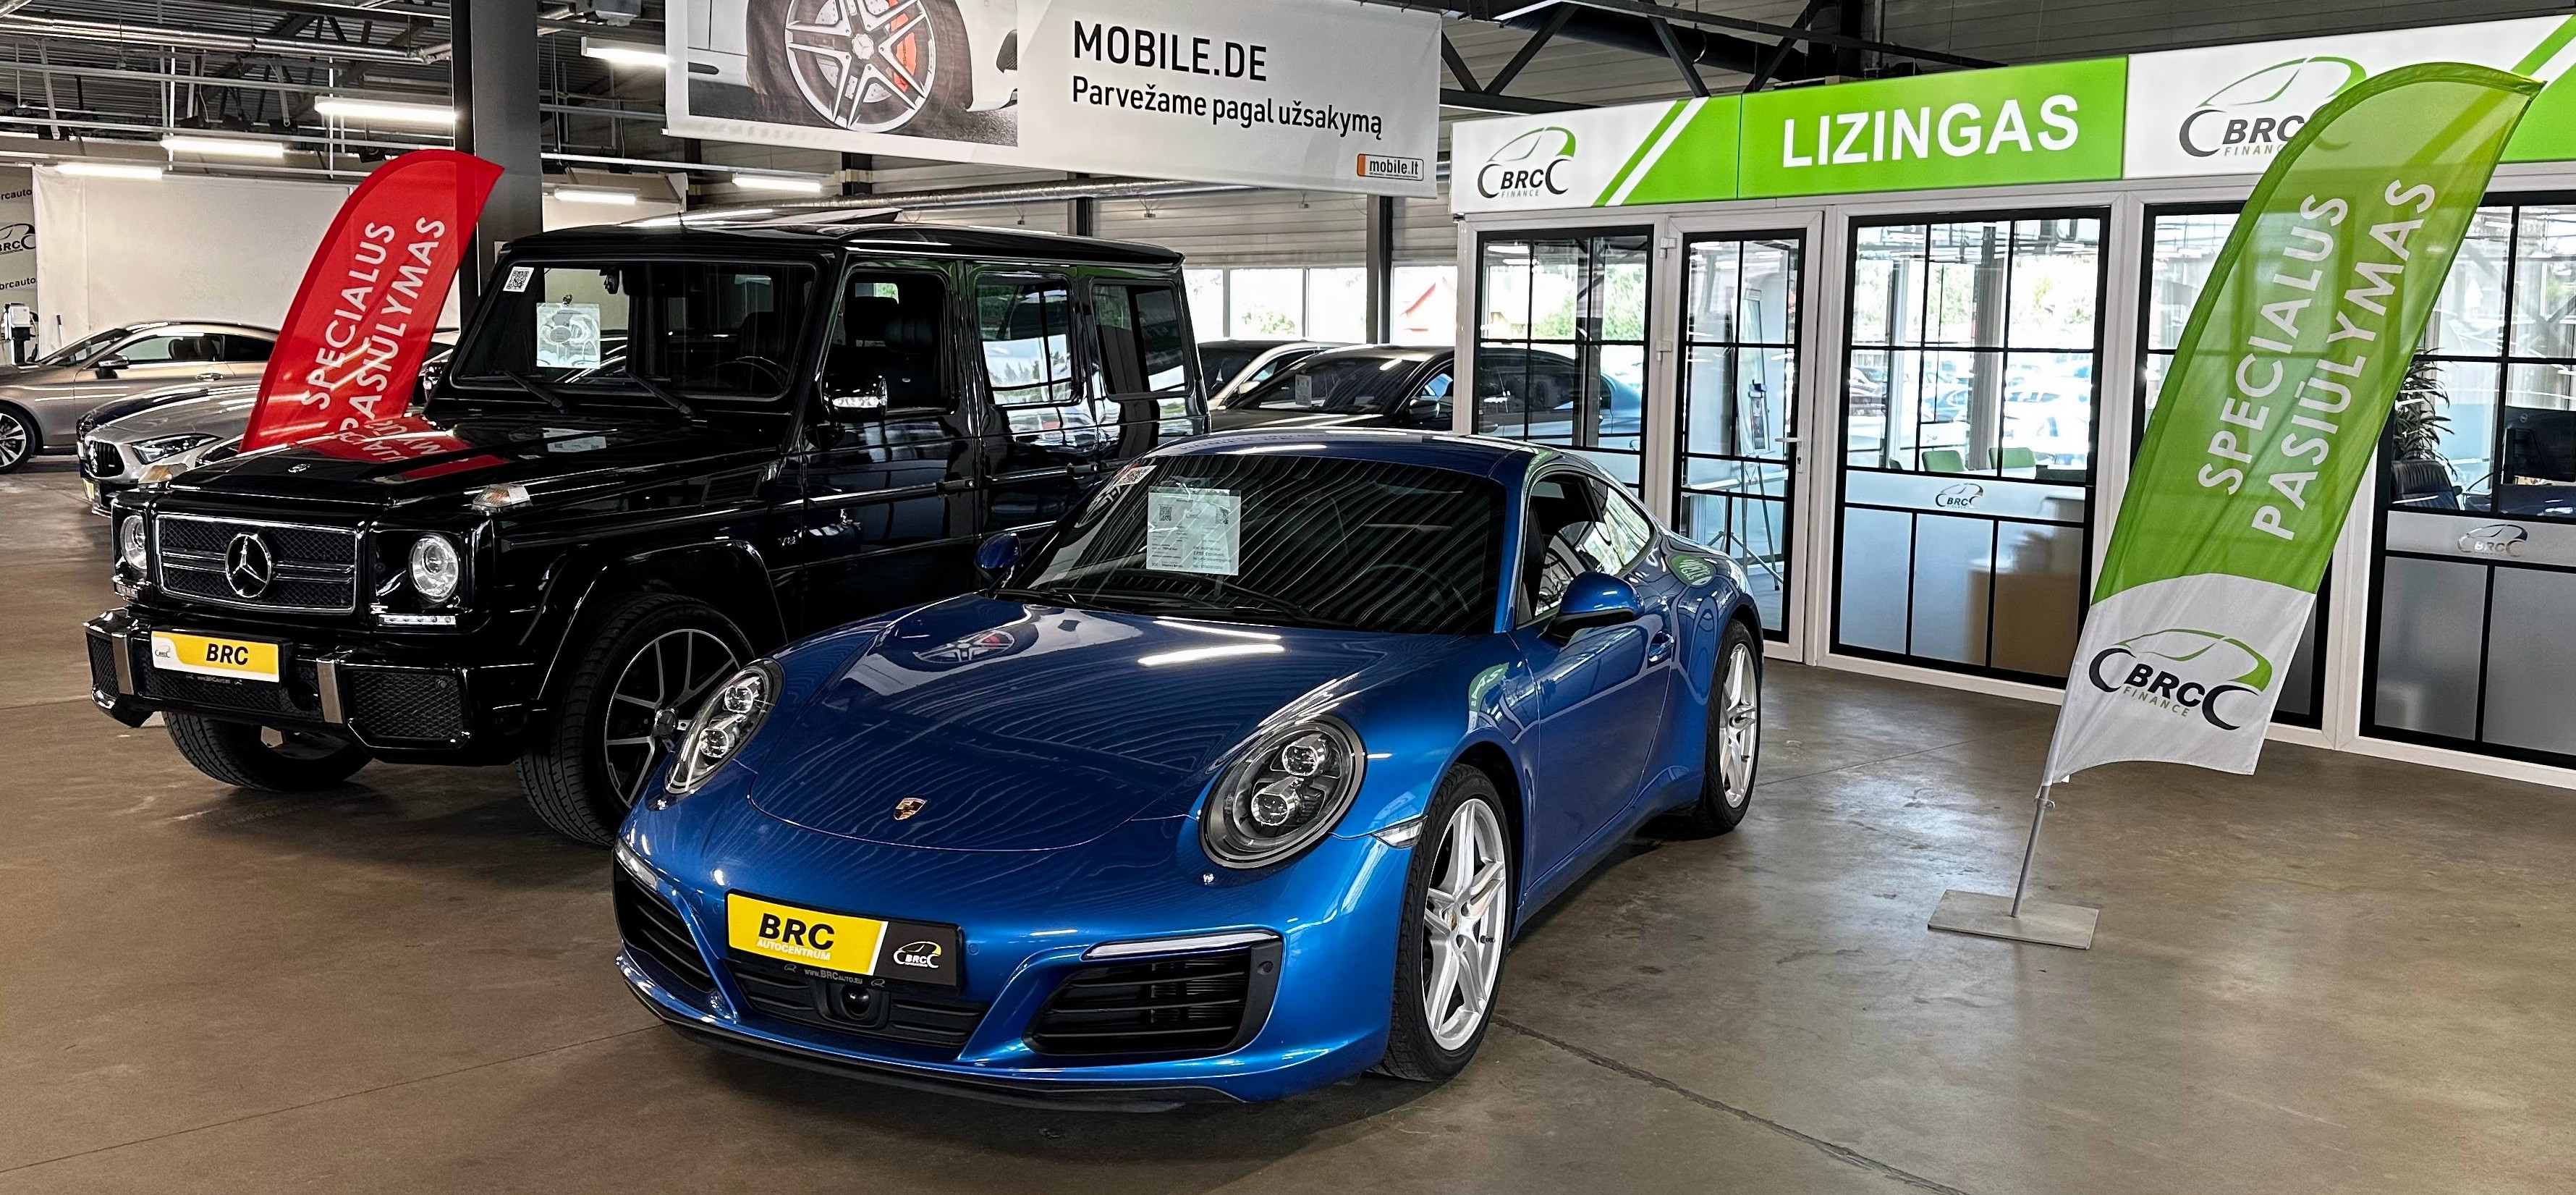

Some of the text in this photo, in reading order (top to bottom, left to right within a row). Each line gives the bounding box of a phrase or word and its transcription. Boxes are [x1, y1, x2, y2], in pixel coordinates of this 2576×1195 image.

[1074, 20, 1267, 81] MOBILE.DE
[1073, 75, 1382, 140] Parvežame pagal užsakymą
[1783, 94, 2079, 168] LIZINGAS
[1369, 159, 1418, 174] mobile.lt
[2224, 145, 2283, 156] FINAN
[1, 189, 33, 200] rcauto
[1501, 189, 1540, 198] FINANCE
[302, 221, 395, 410] SPECIALUS
[2198, 194, 2348, 495] SPECIALUS
[2251, 179, 2435, 541] PASIŪLYMAS
[206, 643, 249, 665] BRC
[2123, 686, 2190, 717] FINANCE
[2124, 663, 2206, 707] BRC
[756, 938, 831, 961] AUTOCENTRUM
[758, 913, 835, 950] BRC
